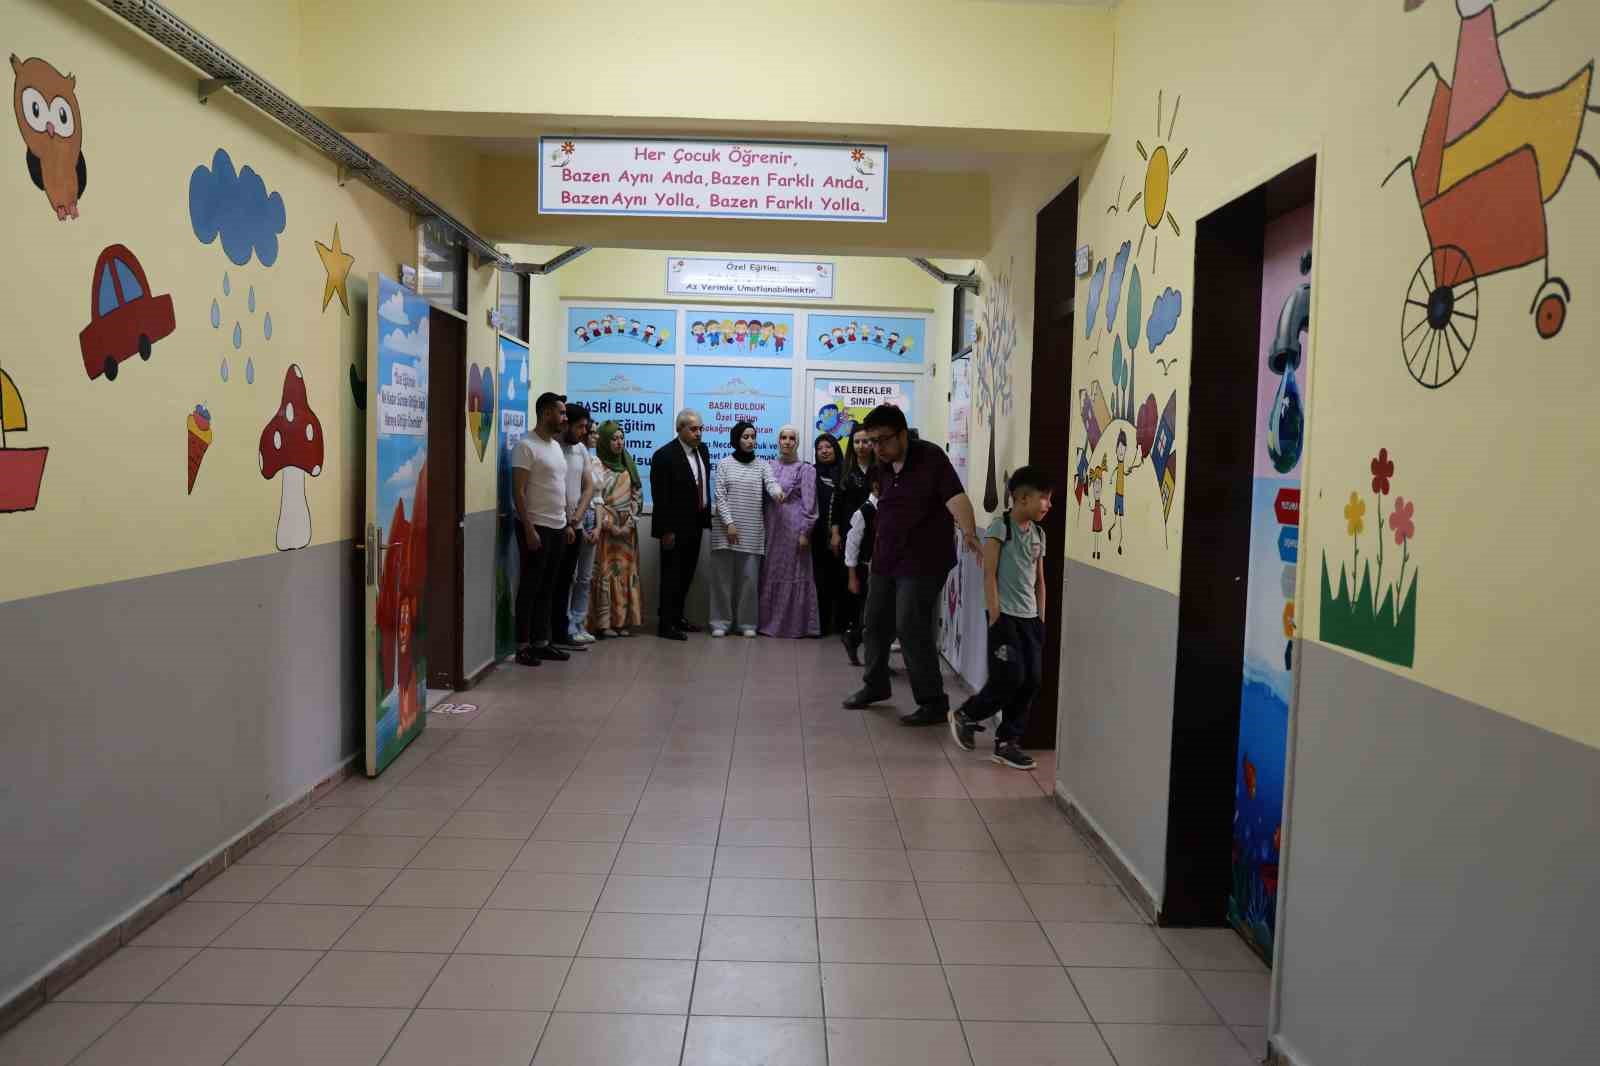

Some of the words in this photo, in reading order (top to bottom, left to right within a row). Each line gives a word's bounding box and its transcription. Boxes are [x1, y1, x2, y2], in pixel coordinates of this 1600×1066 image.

[634, 147, 666, 161] Her
[673, 147, 721, 164] Çocuk
[728, 146, 798, 167] Öğrenir,
[562, 168, 610, 184] Bazen
[618, 170, 654, 187] Aynı
[767, 172, 814, 188] Farklı
[822, 175, 870, 192] Anda,
[561, 190, 609, 205] Bazen
[612, 192, 647, 209] Aynı
[655, 192, 700, 209] Yolla,
[710, 194, 758, 209] Bazen
[766, 195, 813, 210] Farklı
[821, 197, 866, 212] Yolla.
[726, 262, 746, 272] Özel
[834, 385, 892, 395] KELEBEKLER
[708, 400, 732, 410] BASRİ
[734, 402, 766, 411] BULDUK
[850, 397, 876, 406] SINIFI
[615, 402, 664, 415] BULDUK
[715, 412, 732, 421] Özel
